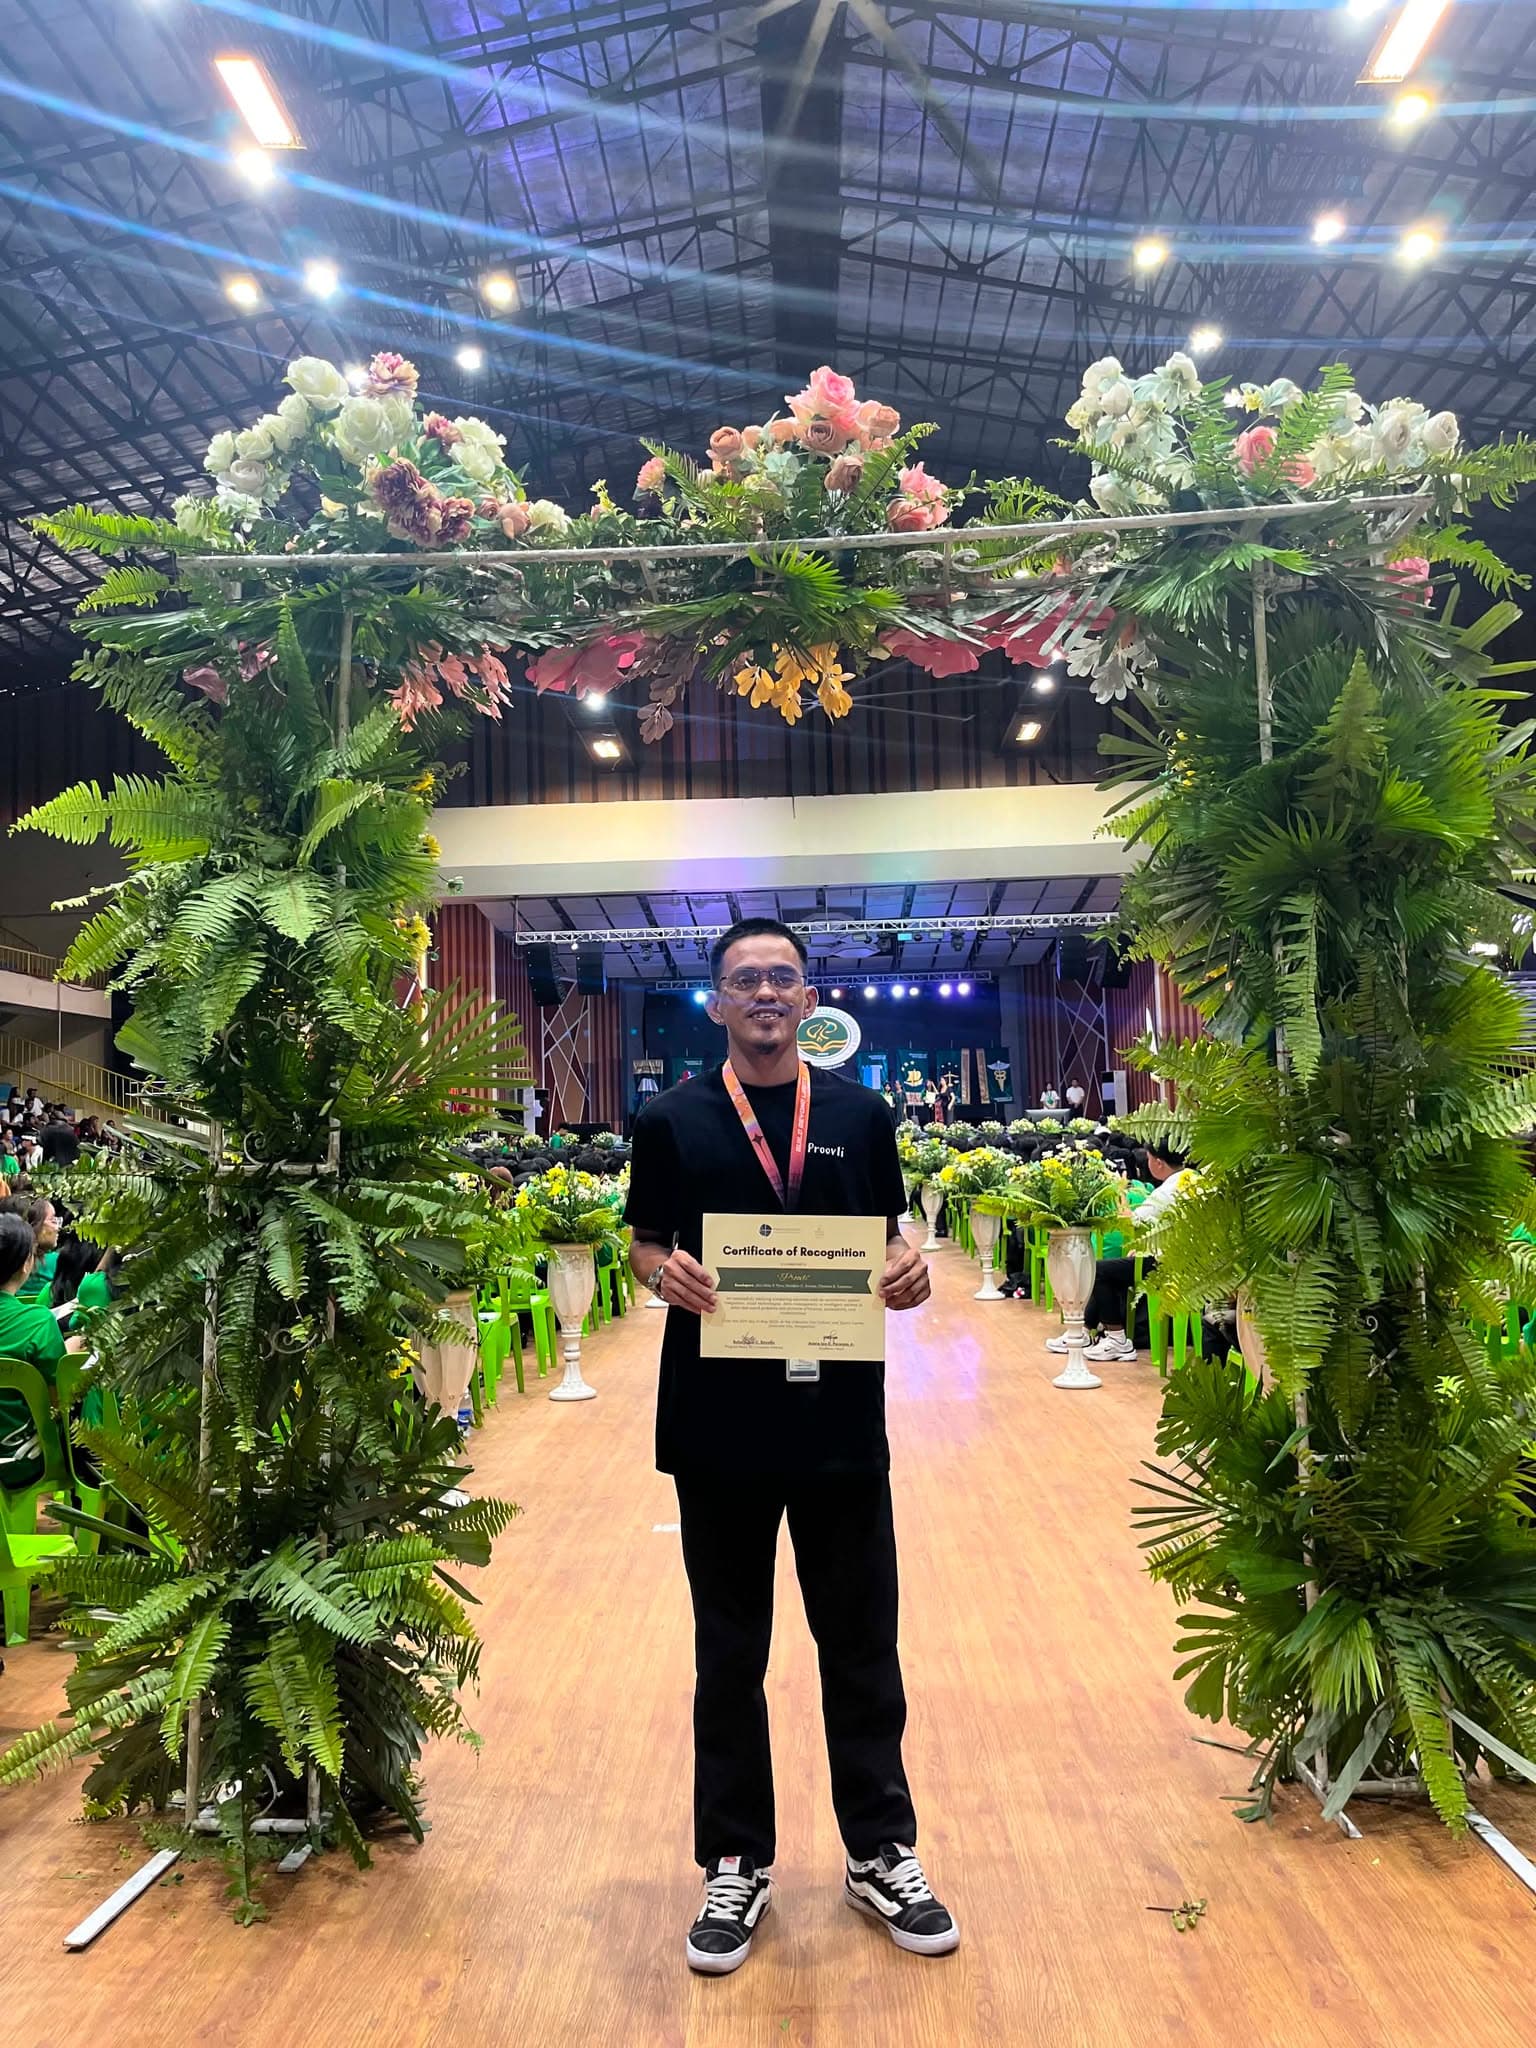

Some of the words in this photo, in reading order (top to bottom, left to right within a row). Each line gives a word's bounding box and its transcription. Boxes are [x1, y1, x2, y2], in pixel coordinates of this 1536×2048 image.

[807, 1142, 845, 1158] Proovli
[722, 1245, 783, 1257] Certificate
[786, 1246, 798, 1257] of
[800, 1247, 866, 1259] Recognition
